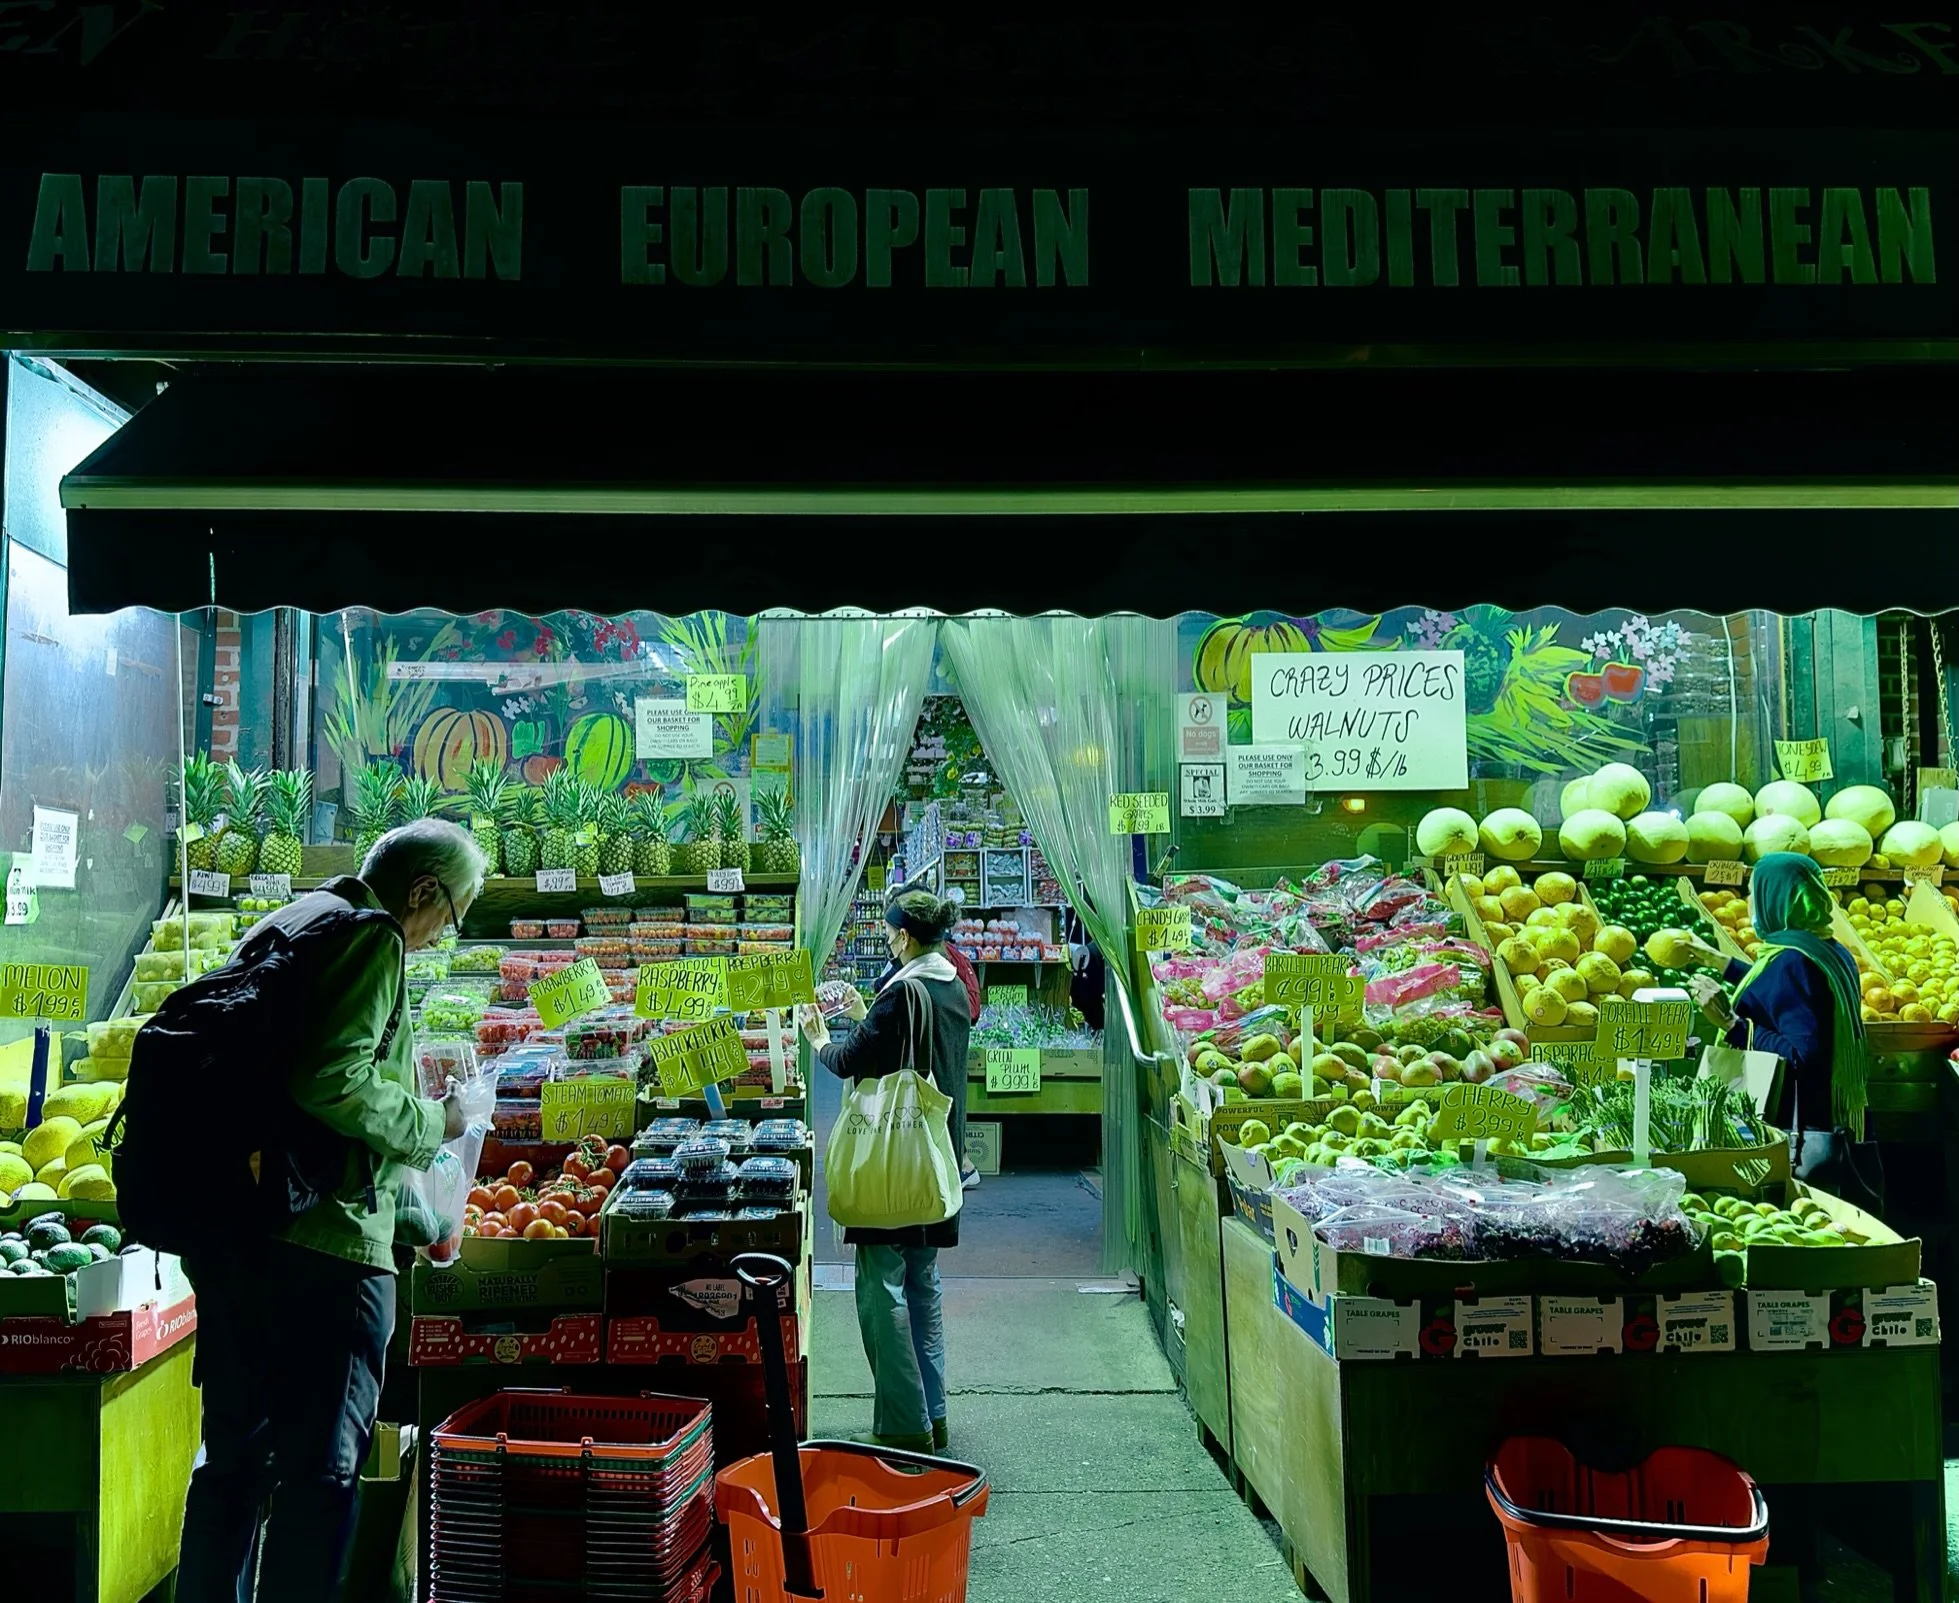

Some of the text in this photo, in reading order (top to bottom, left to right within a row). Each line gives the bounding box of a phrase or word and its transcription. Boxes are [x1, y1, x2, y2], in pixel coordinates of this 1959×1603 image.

[26, 172, 1937, 289] AMERICAN EUROPEAN MEDITERRANEAN
[1270, 662, 1458, 701] CRAZY PRICES
[656, 724, 690, 732] SHOPPING
[1288, 707, 1419, 743] WALNUTS
[1186, 729, 1216, 738] No dogs
[1304, 748, 1361, 781] 3.99
[1185, 769, 1219, 777] SPECIAL
[1110, 794, 1168, 808] RED SEEDED
[1197, 806, 1216, 814] 3.99
[1137, 910, 1172, 926] CANDY
[728, 950, 802, 972] RASPBERRY
[1264, 955, 1315, 974] BARTLETT
[4, 964, 81, 990] MELON
[529, 958, 598, 1000] STRAWBERRY
[639, 964, 719, 995] RASPBERRY
[1600, 1001, 1690, 1025] FORELLE PEAR
[987, 1050, 1013, 1063] GREEN
[1532, 1044, 1616, 1064] ASPARAG
[542, 1084, 635, 1104] STEAM TOMATO
[1444, 1085, 1532, 1116] CHERRY
[847, 1127, 866, 1136] LOVE
[478, 1274, 538, 1286] NATURALLY
[478, 1285, 538, 1297] RIPENED
[1573, 1307, 1604, 1315] GRAPES
[1780, 1301, 1810, 1309] GRAPES
[1370, 1310, 1400, 1318] GRAPES
[11, 1334, 71, 1345] RIOblanco
